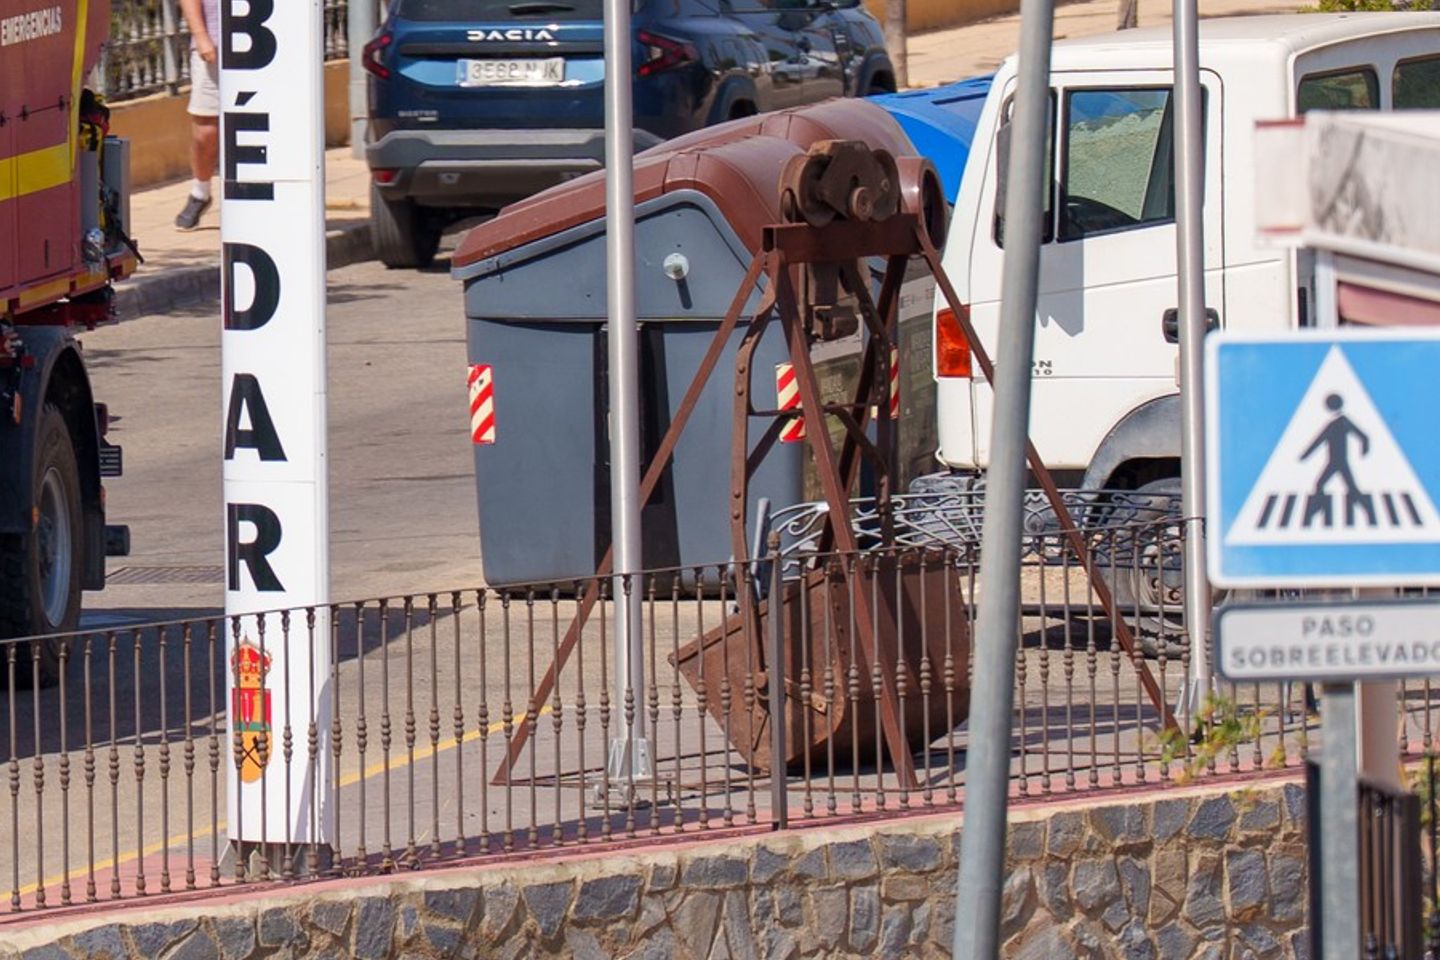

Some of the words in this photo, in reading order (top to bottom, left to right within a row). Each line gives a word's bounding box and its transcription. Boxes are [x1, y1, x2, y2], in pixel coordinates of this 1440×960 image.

[0, 5, 61, 47] EMERGENCIAS
[467, 30, 553, 41] DACIA
[1302, 615, 1375, 638] PASO
